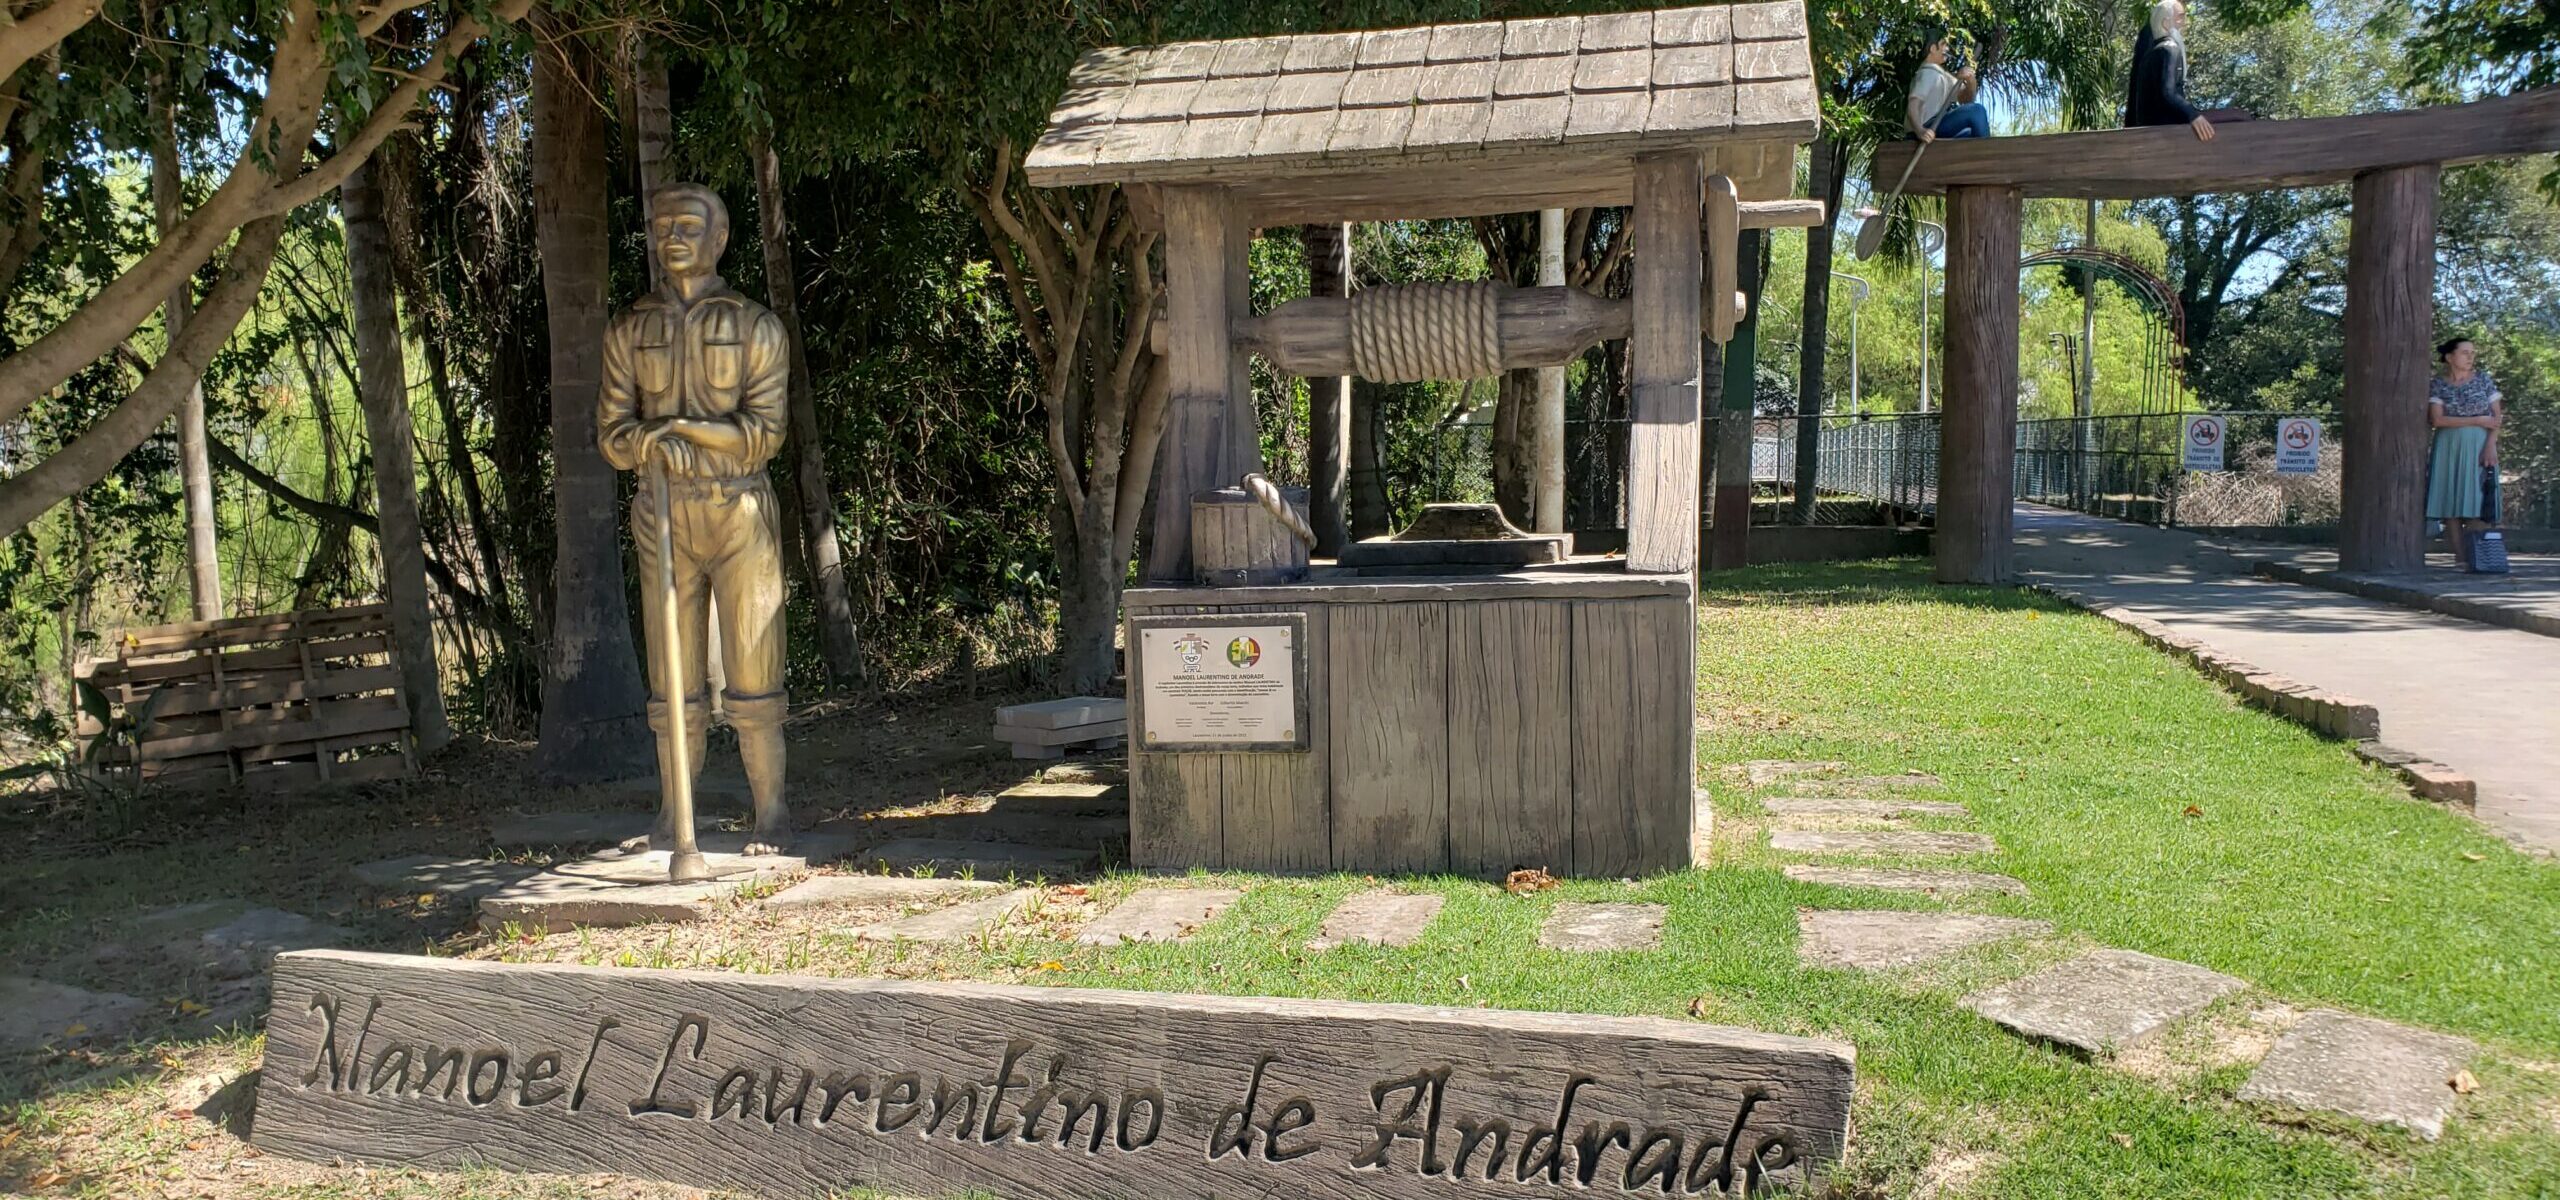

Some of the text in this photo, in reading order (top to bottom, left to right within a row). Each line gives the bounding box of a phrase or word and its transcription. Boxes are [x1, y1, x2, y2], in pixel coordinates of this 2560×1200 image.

[301, 991, 1799, 1198] Manoel Laurentino de Andrade
